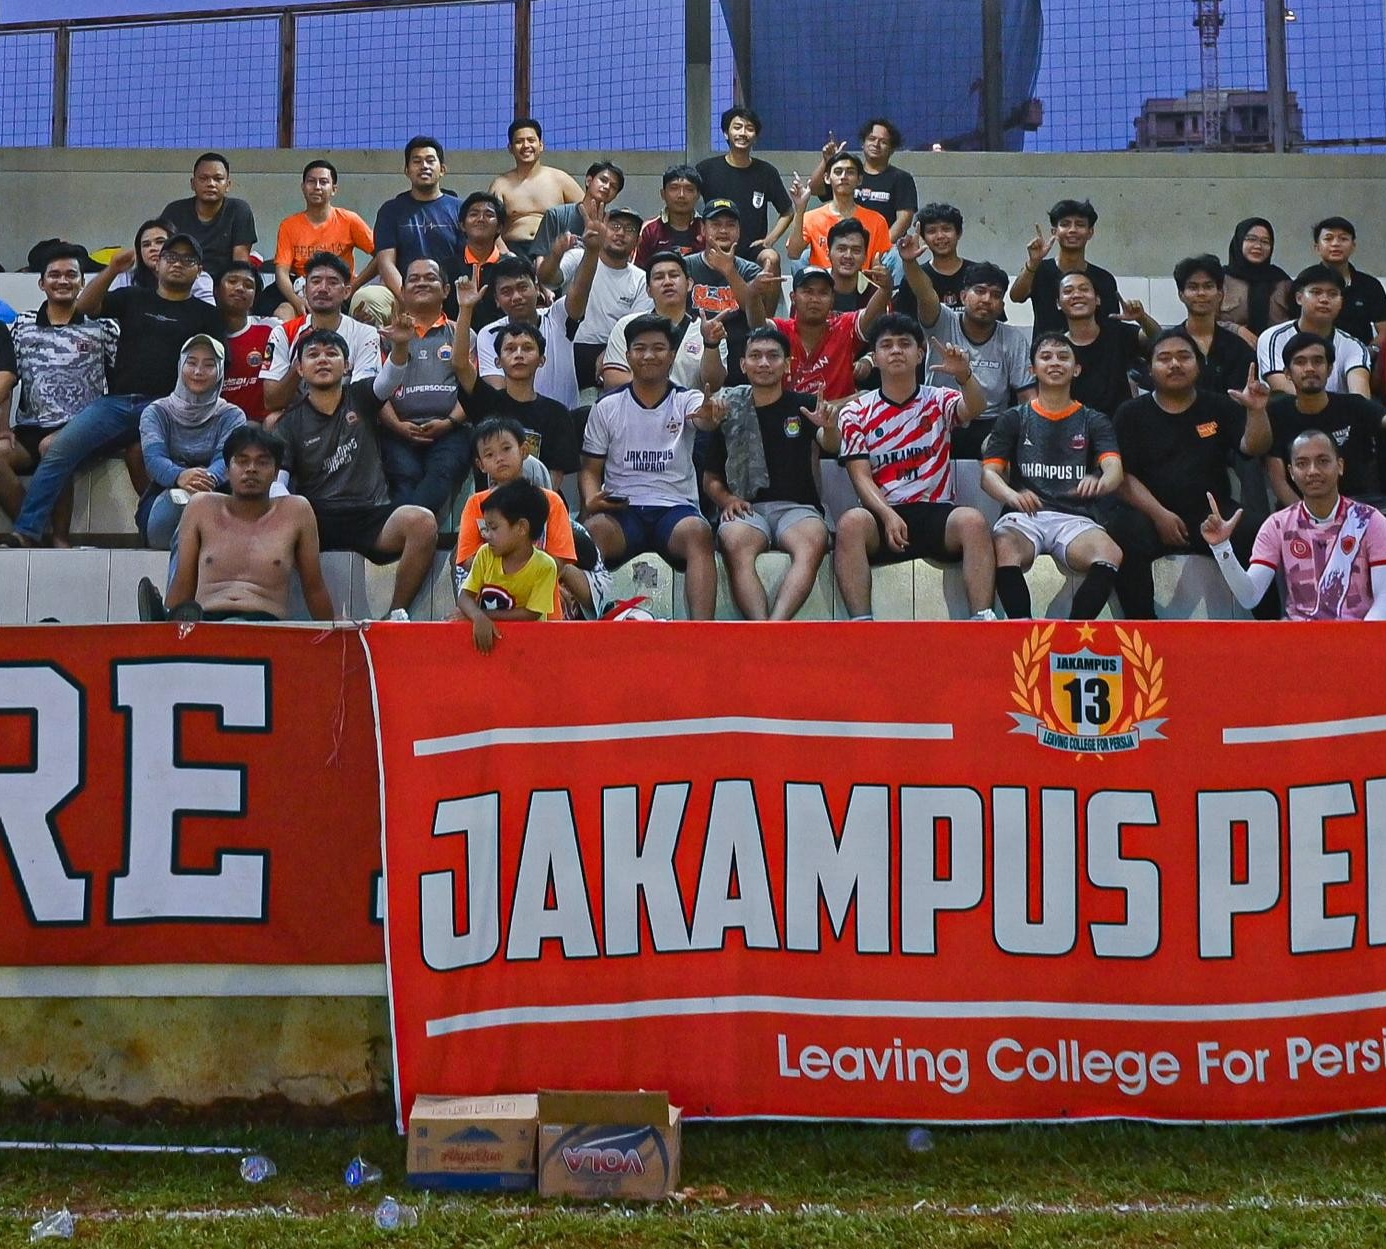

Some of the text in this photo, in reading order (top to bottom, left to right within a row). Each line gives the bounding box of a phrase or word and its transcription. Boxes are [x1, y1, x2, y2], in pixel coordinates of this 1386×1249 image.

[624, 448, 674, 462] JAKAMPUS
[1018, 463, 1073, 480] AKAMPUS
[1056, 657, 1117, 671] JAKAMPUS
[1063, 678, 1111, 725] 13
[1043, 731, 1135, 752] LEAVING COLLEGE FOR PERSIJA
[418, 778, 1163, 973] JAKAMPUS
[777, 1033, 970, 1095] Leaving
[986, 1038, 1180, 1096] College
[1197, 1041, 1271, 1085] For
[563, 1148, 645, 1176] VOLA
